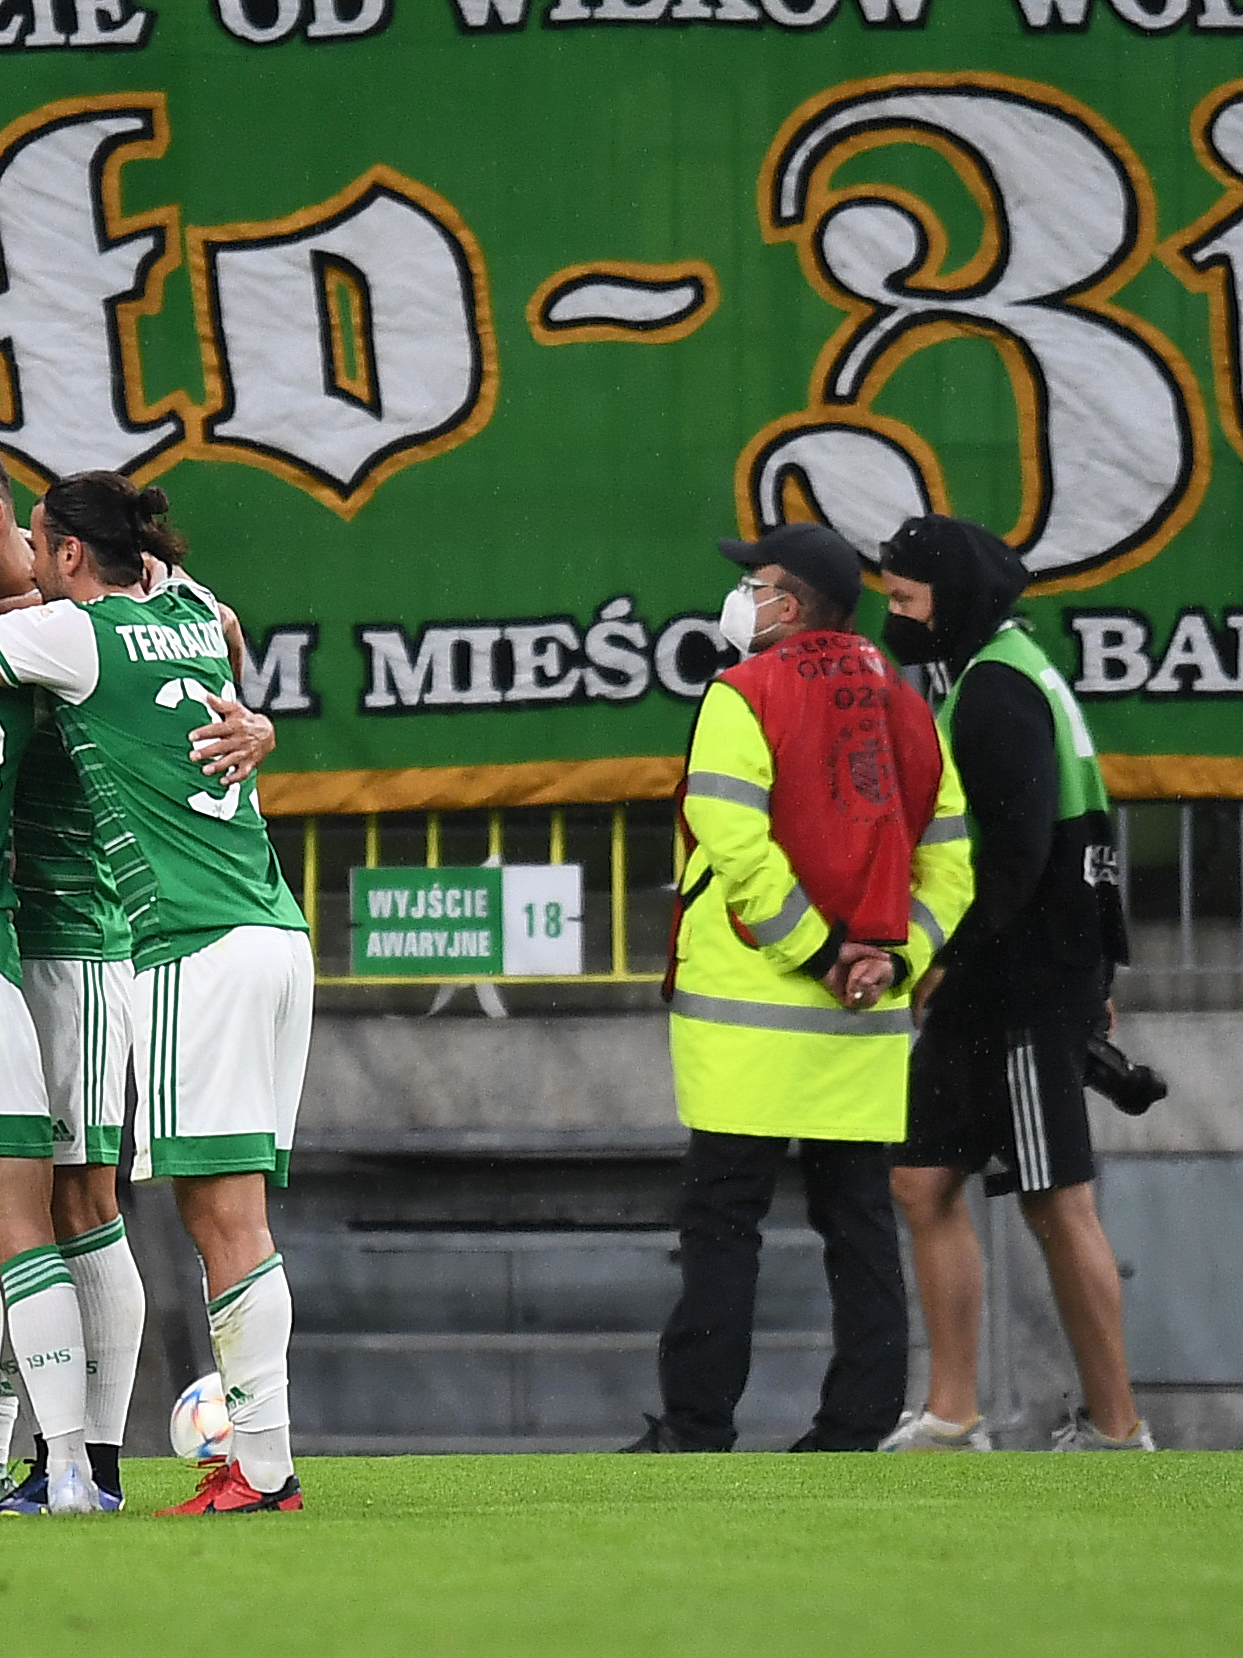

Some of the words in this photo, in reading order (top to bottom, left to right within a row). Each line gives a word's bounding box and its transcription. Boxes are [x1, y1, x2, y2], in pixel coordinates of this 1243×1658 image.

[362, 596, 729, 708] MIEŚC
[1072, 614, 1243, 692] BA
[367, 883, 488, 919] WYJŚCIE
[523, 901, 563, 939] 18
[366, 930, 492, 958] AWARYJNE
[26, 1348, 72, 1370] 1945
